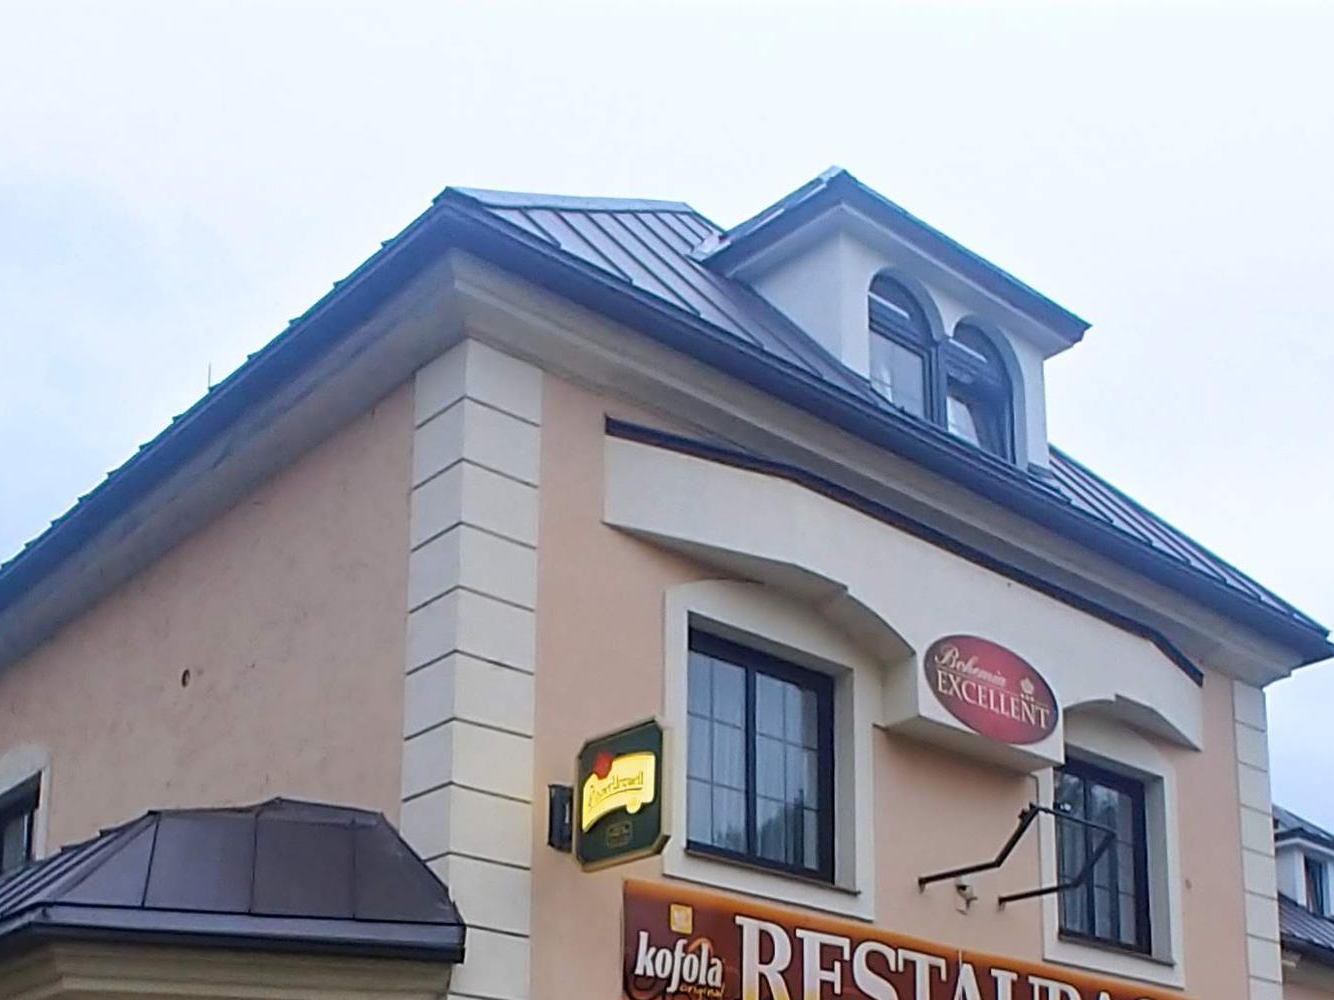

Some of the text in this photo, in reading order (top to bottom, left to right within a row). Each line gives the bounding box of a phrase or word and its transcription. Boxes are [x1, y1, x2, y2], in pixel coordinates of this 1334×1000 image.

[934, 643, 1007, 688] Bohemia
[937, 669, 1050, 729] EXCELLENT
[634, 930, 723, 993] kofola
